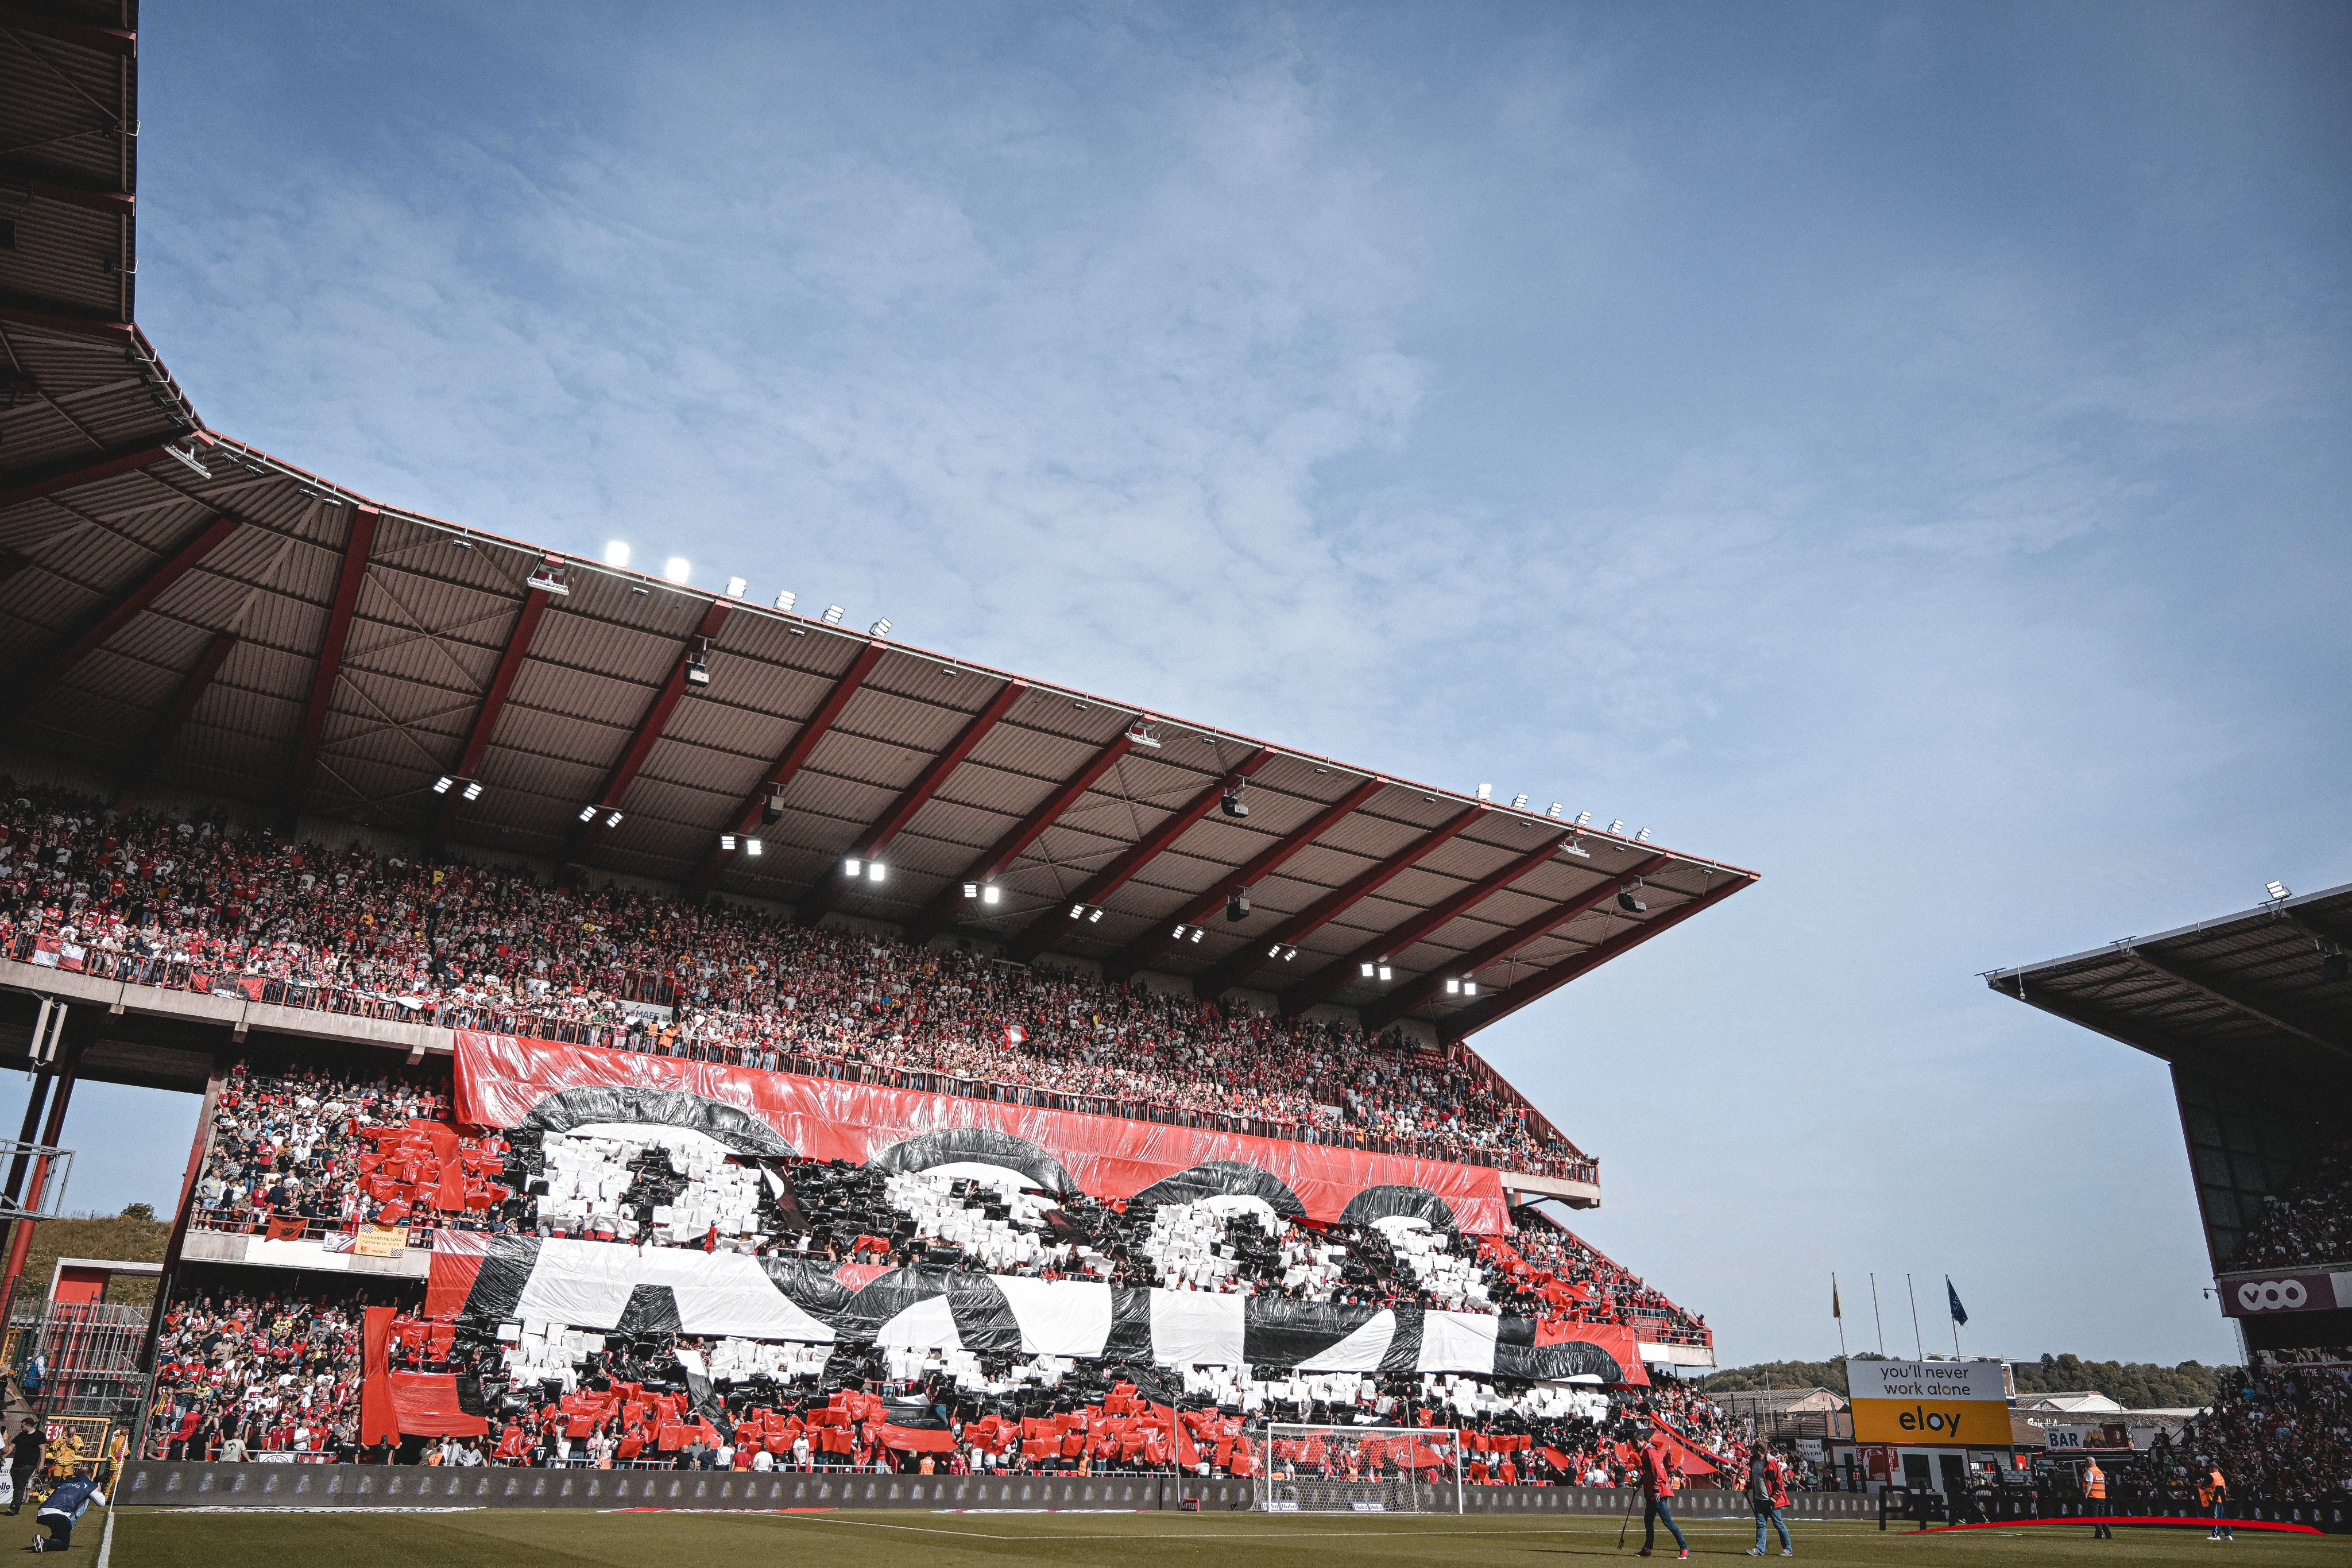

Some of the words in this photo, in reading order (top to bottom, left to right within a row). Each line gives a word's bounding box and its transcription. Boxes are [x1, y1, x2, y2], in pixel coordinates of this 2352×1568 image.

[635, 1009, 659, 1020] MAES
[1925, 1368, 1969, 1379] never
[1883, 1381, 1924, 1395] work
[1927, 1382, 1971, 1395] alone
[1899, 1405, 1961, 1438] eloy
[2048, 1433, 2079, 1447] BAR
[537, 1450, 545, 1461] 17
[1181, 1499, 1197, 1509] Circus
